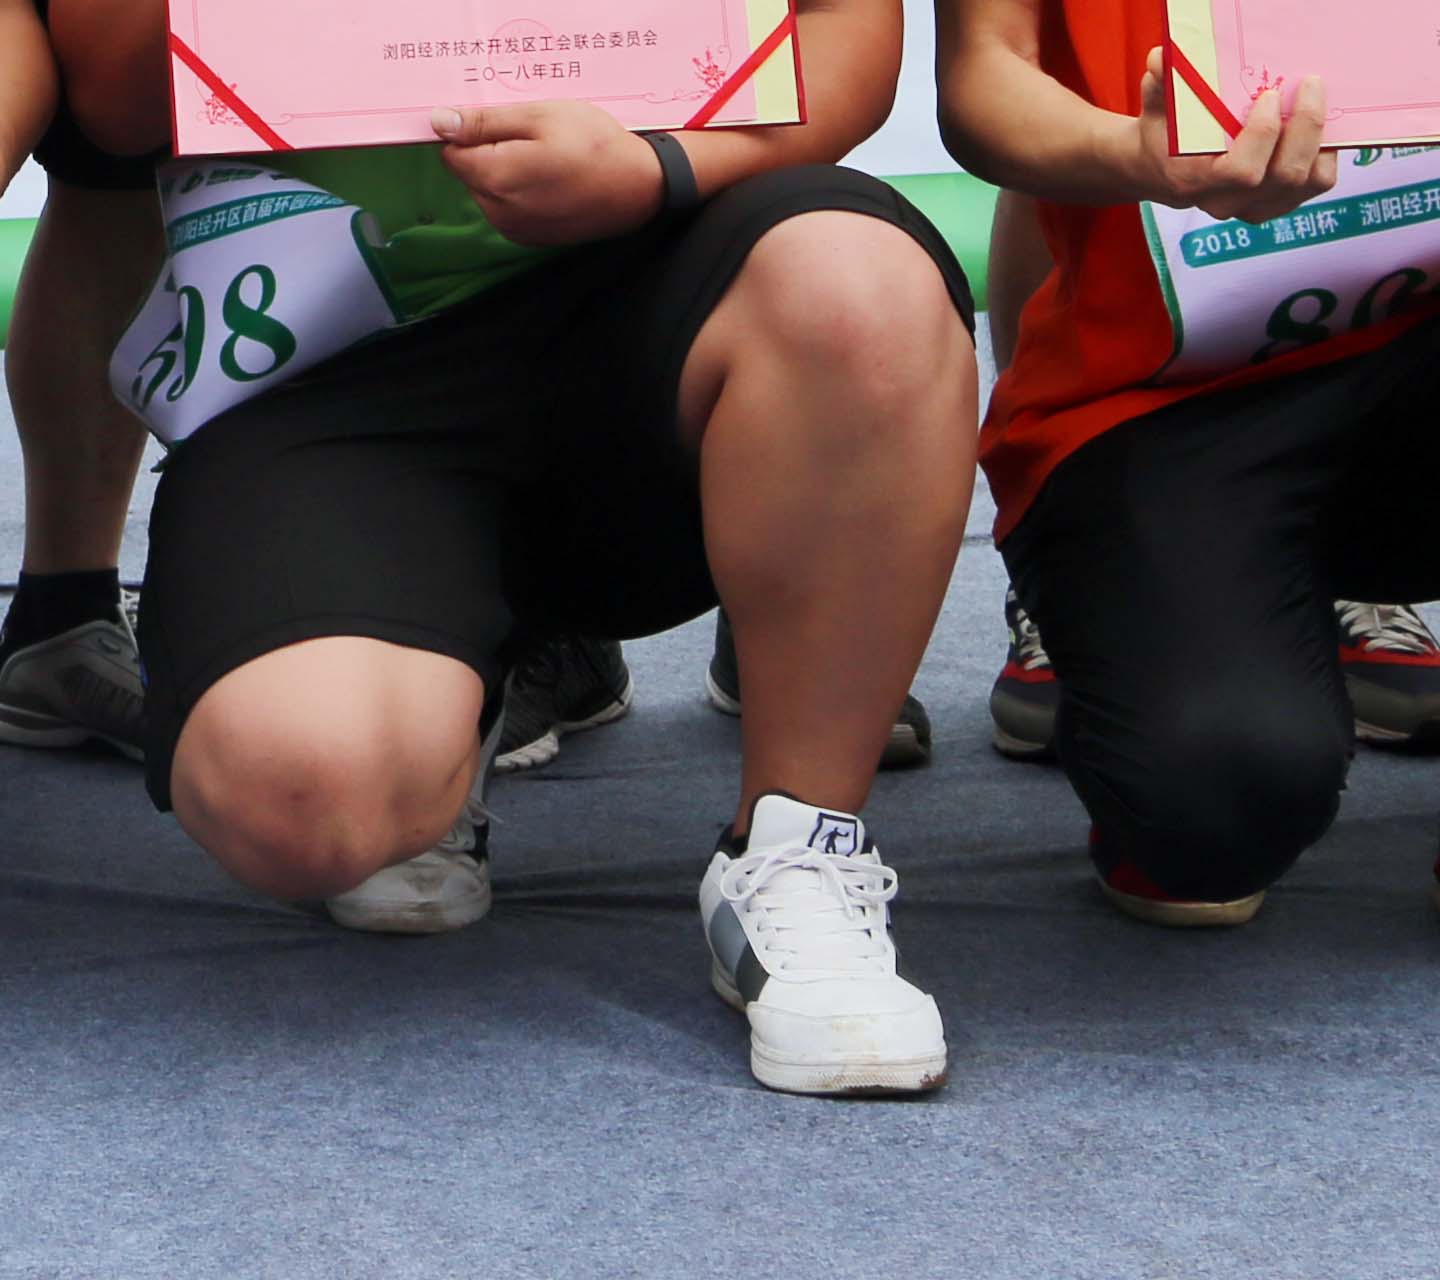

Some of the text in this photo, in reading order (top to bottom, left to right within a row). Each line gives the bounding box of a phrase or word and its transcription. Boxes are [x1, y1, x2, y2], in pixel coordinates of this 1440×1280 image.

[1192, 227, 1252, 258] 2018
[1260, 205, 1348, 245] “嘉利杯”
